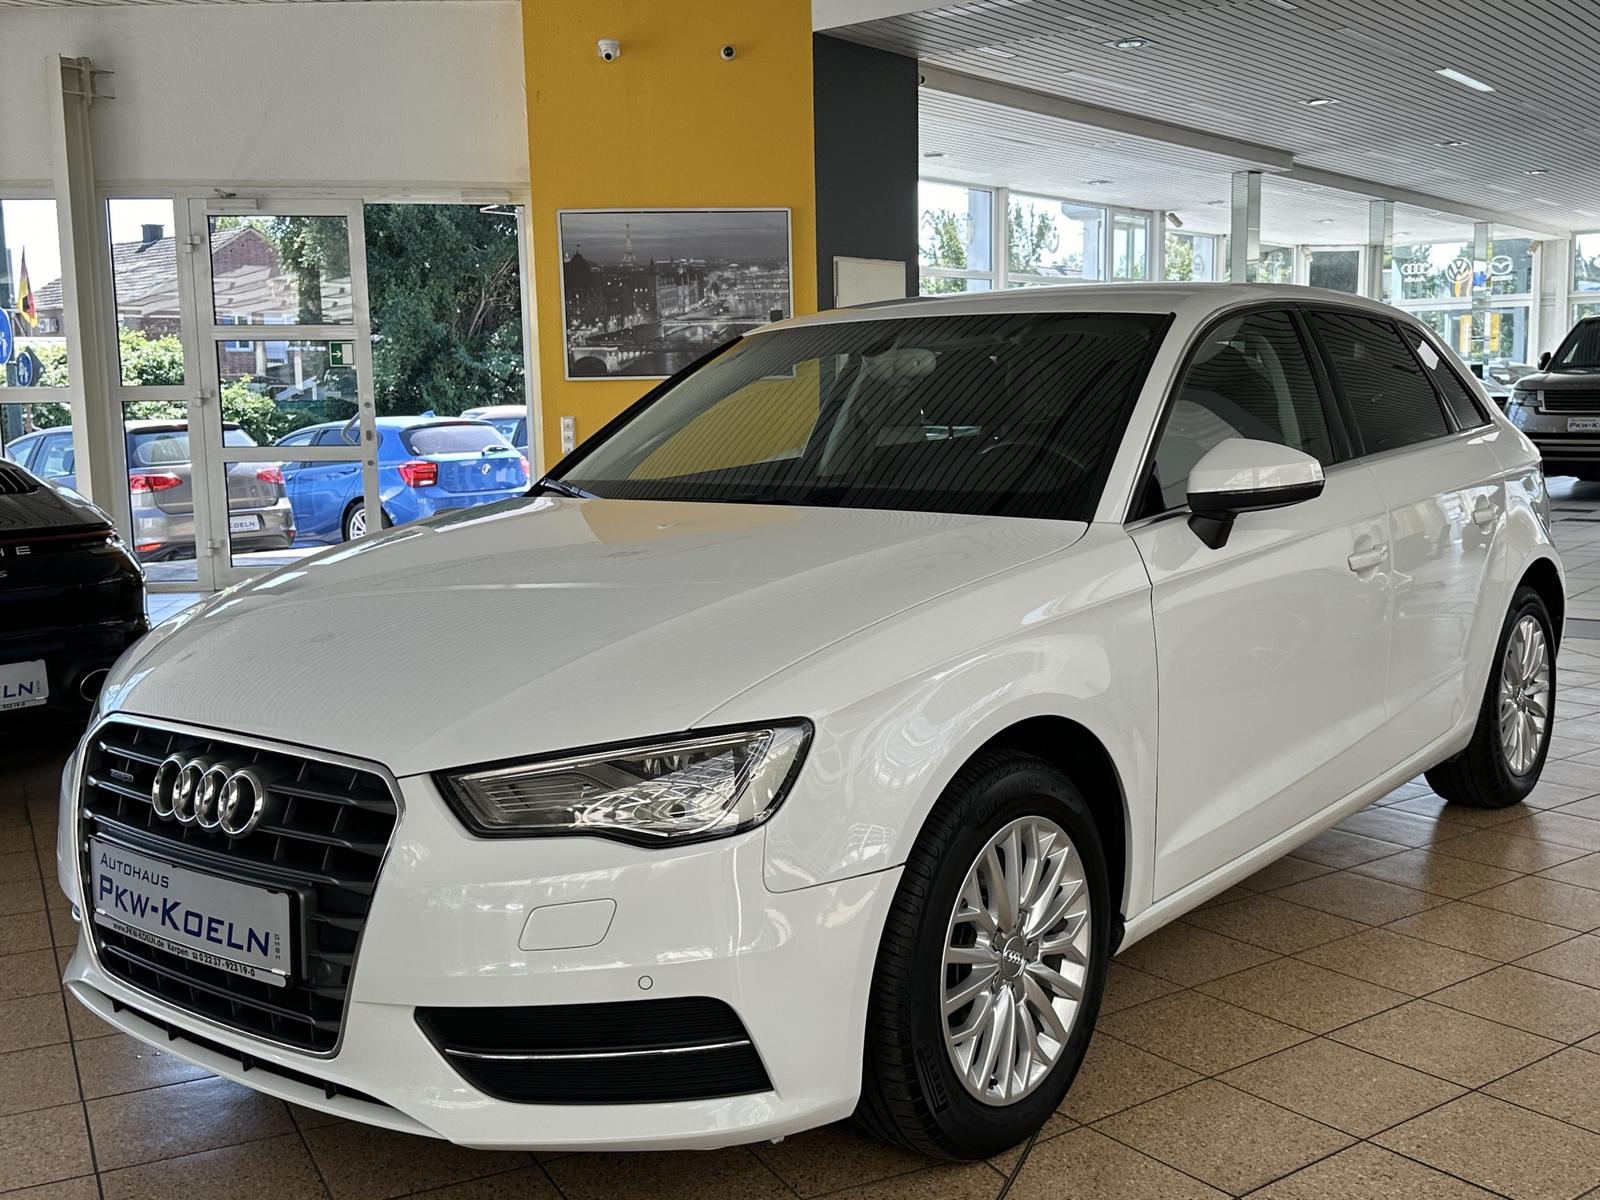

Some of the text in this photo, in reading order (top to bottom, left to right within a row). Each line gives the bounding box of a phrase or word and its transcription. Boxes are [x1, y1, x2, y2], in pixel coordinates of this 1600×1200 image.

[0, 681, 33, 698] LN
[99, 852, 170, 889] AUTOHAUS
[99, 873, 270, 957] PKW-KOELN
[167, 941, 189, 957] Kerpen
